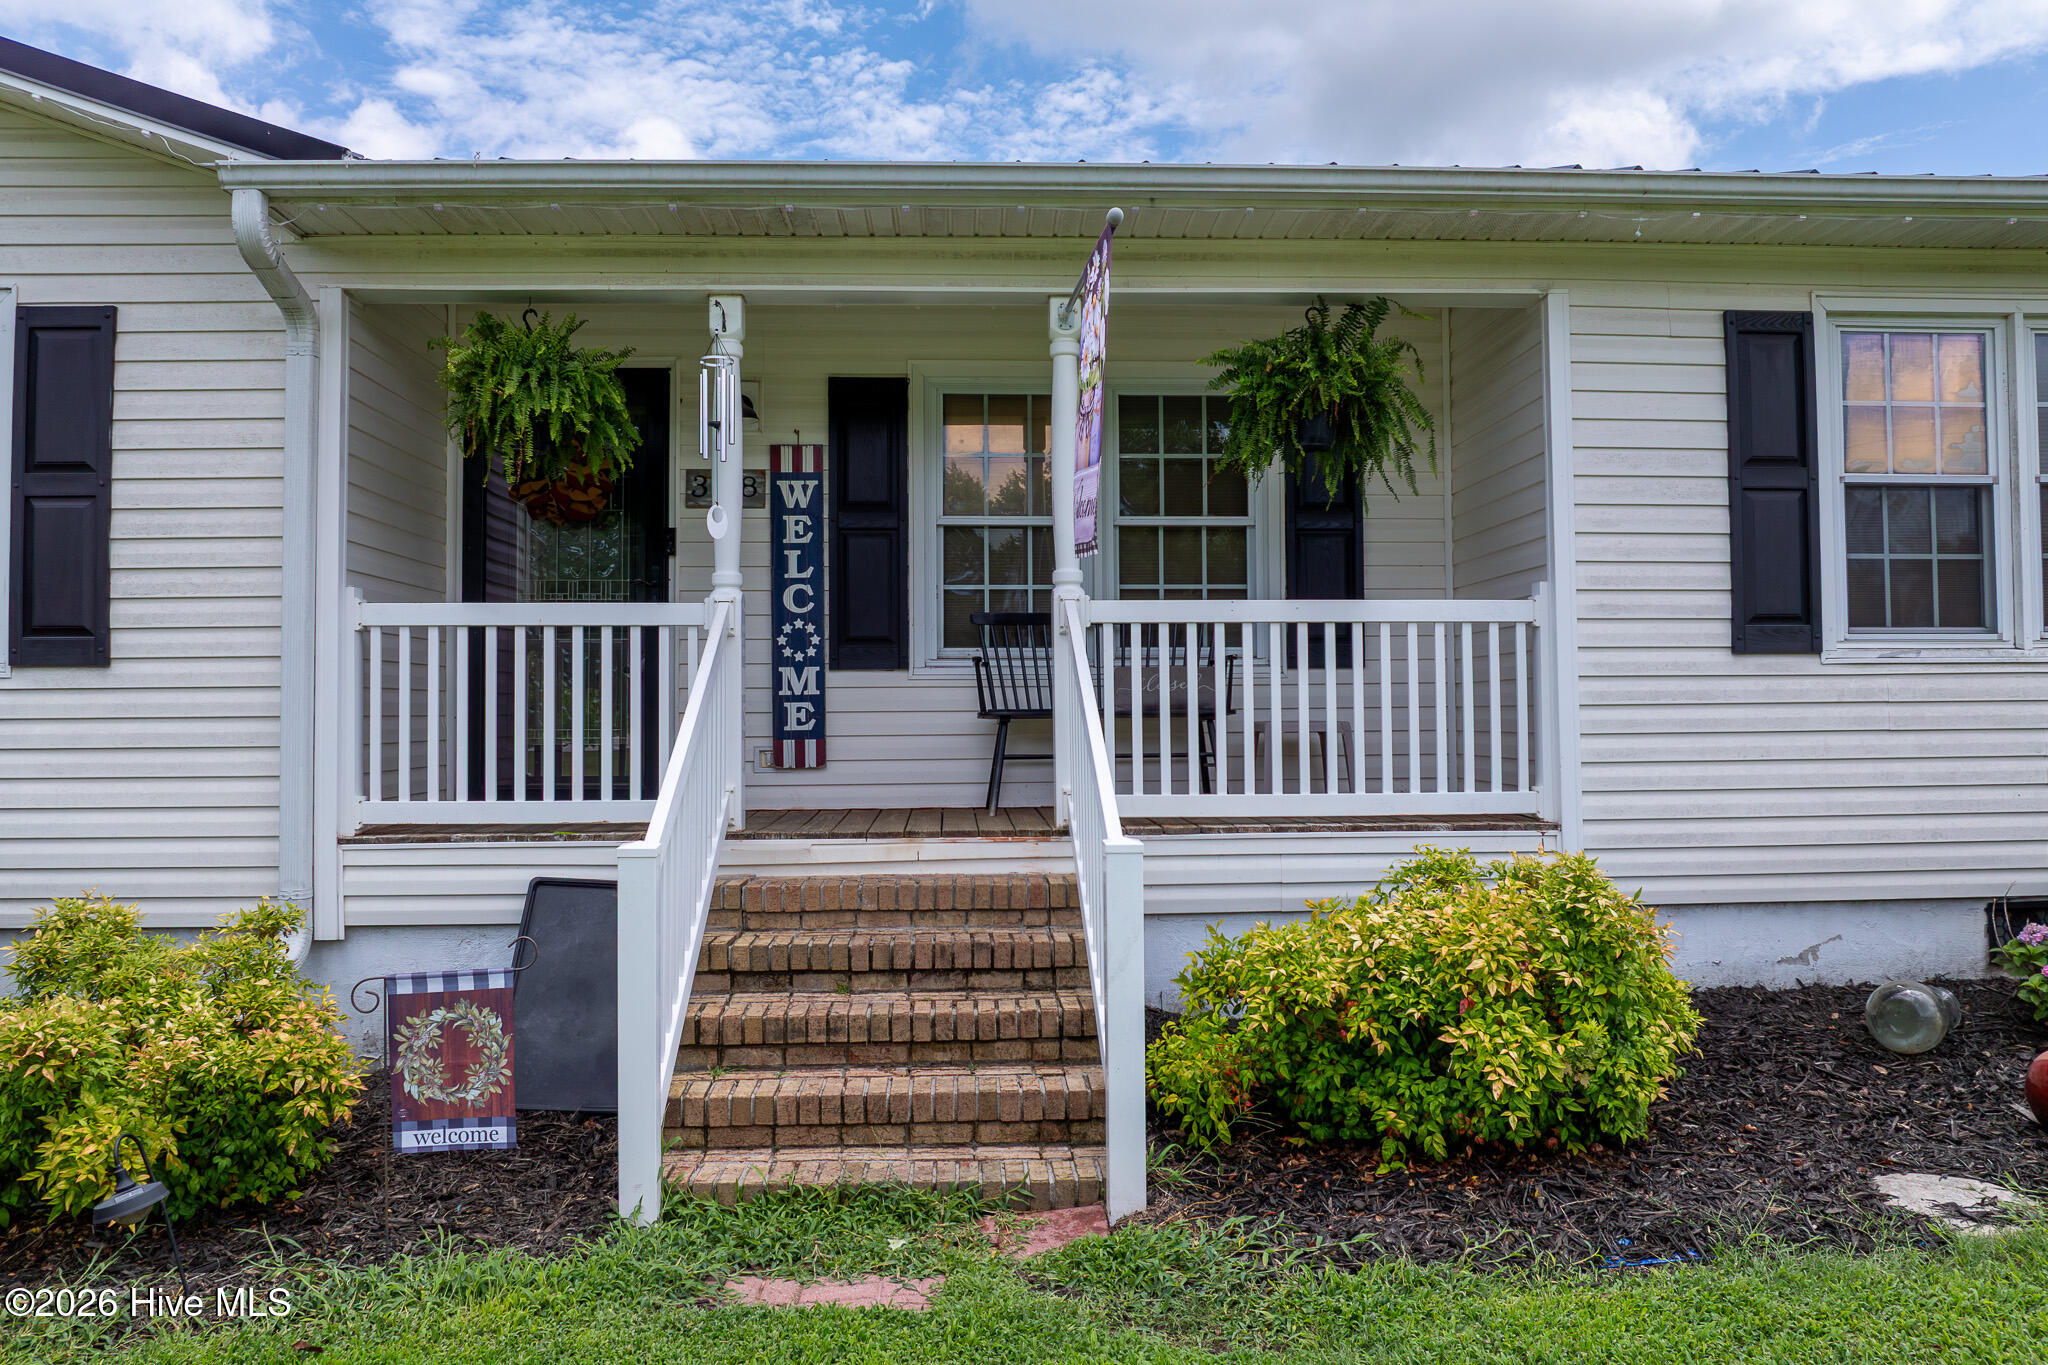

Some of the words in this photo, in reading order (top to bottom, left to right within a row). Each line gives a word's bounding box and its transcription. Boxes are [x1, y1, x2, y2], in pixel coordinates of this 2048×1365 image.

[691, 474, 757, 498] 38
[776, 479, 821, 732] WELCOME
[413, 1125, 500, 1146] welcome
